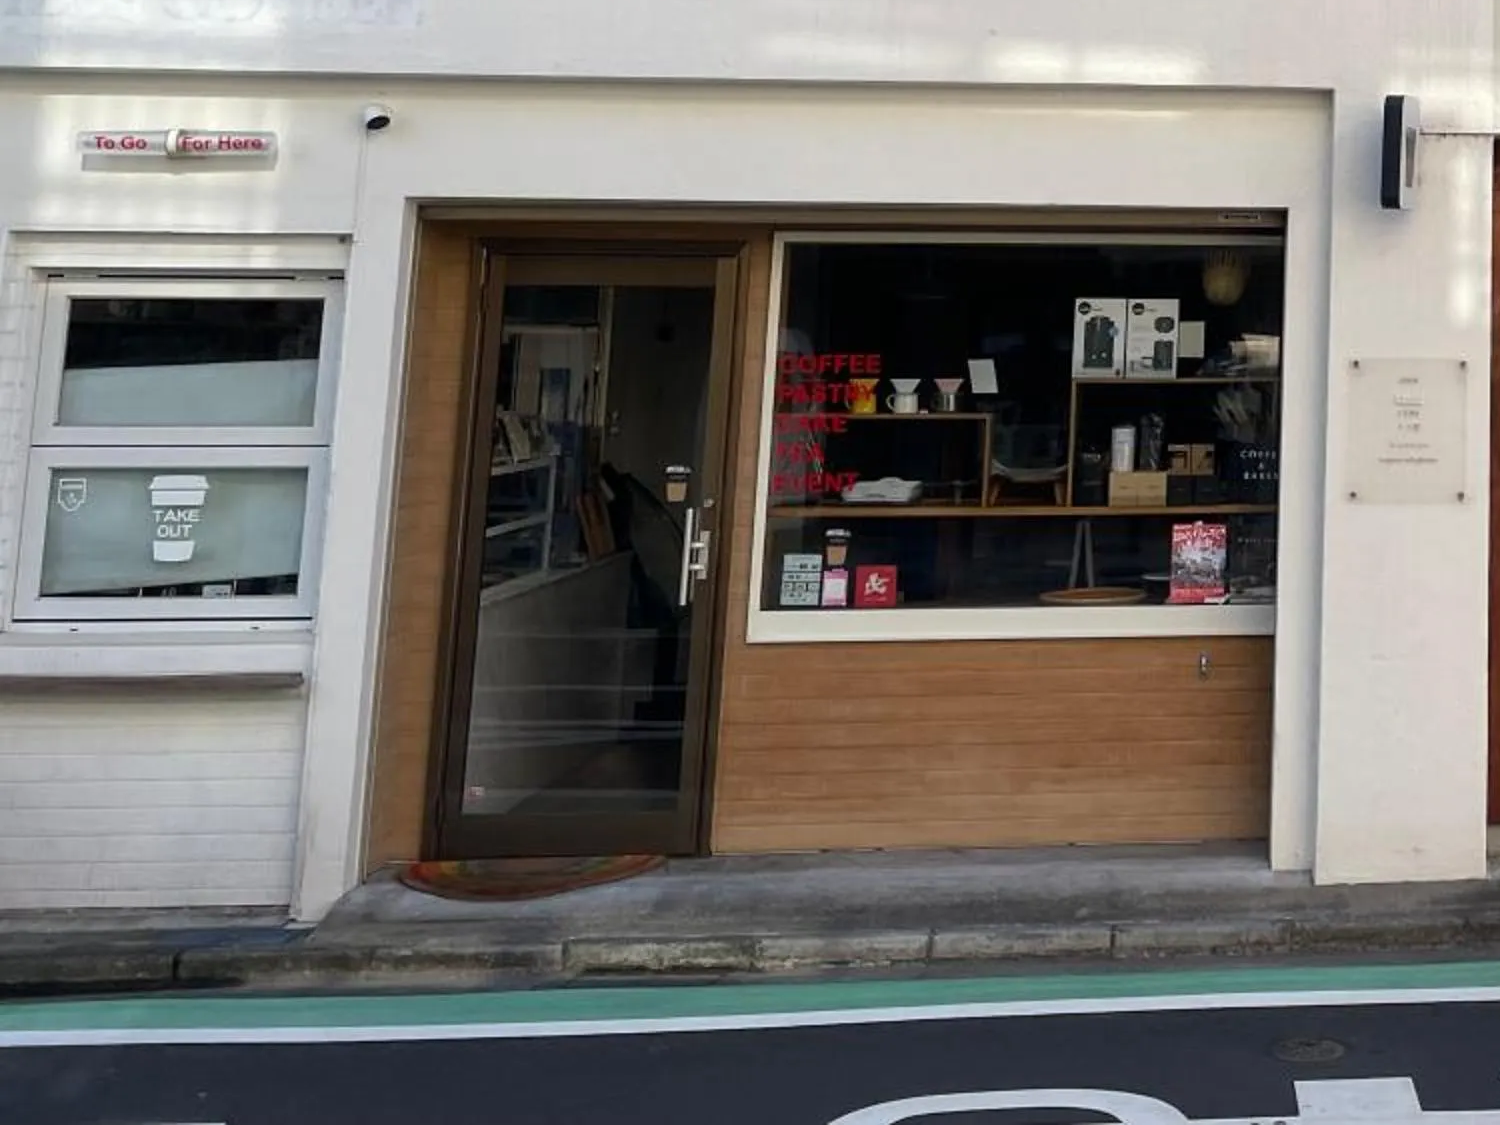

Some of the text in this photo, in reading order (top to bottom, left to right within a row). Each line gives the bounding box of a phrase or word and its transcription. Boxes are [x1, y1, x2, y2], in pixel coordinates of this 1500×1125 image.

[95, 136, 264, 151] To Go For Here
[780, 353, 882, 374] COFFEE
[779, 382, 874, 404] PASTRY
[772, 472, 859, 493] EVENT
[152, 509, 201, 523] TAKE
[157, 524, 193, 538] OUT
